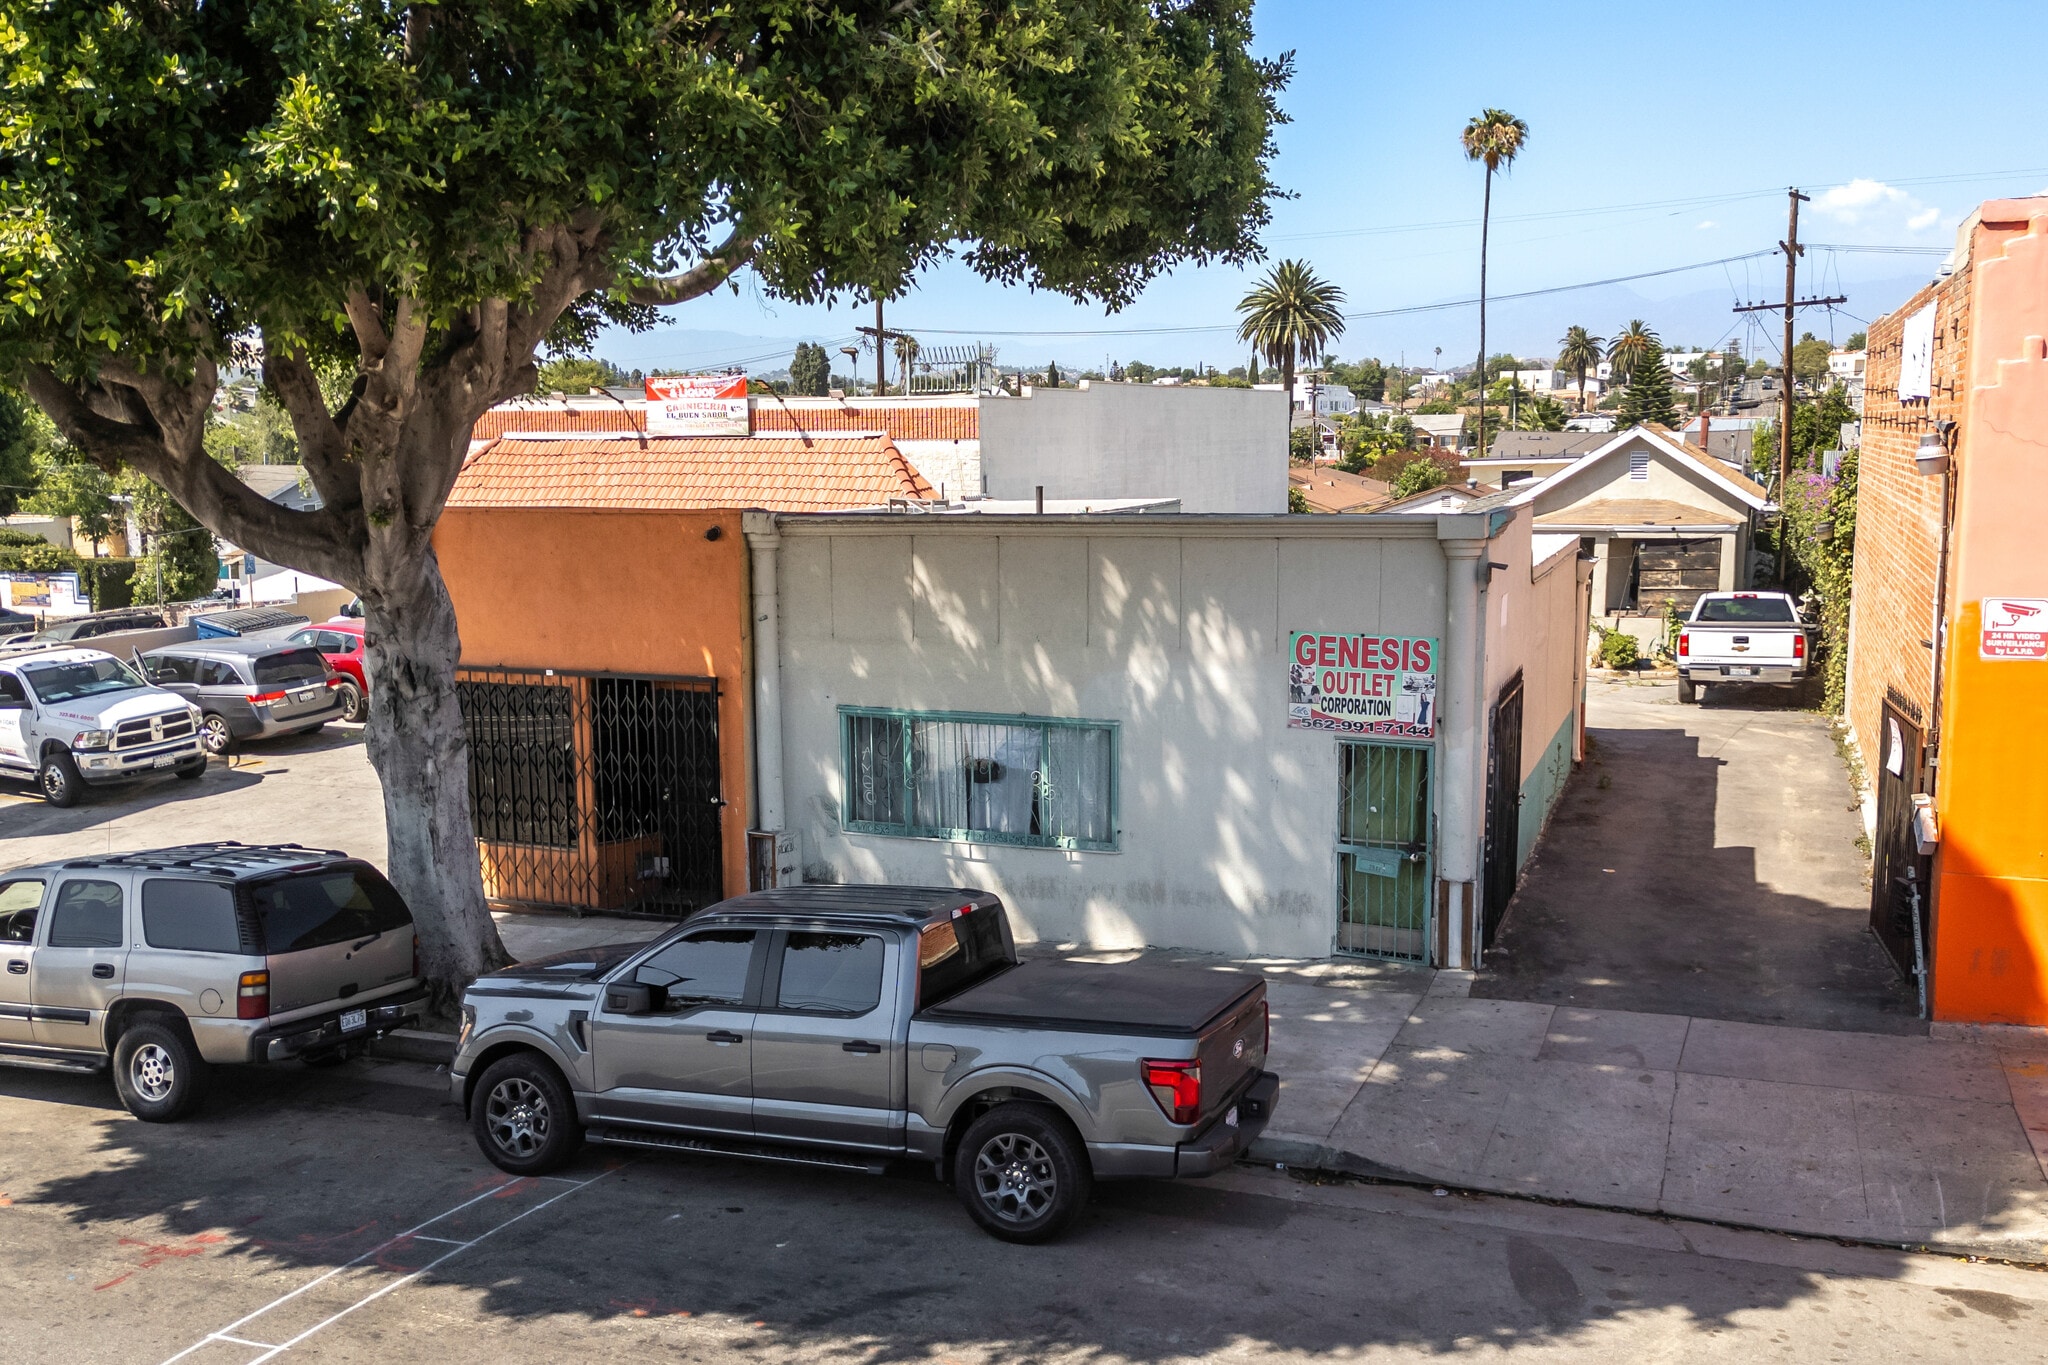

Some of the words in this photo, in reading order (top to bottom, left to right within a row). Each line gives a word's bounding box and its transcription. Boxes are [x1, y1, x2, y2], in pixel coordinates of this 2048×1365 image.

[679, 387, 716, 398] LIQUOR
[666, 402, 727, 412] CARNICERIA
[1295, 634, 1431, 673] GENESIS
[1986, 639, 2046, 648] SURVEILLANCE
[1322, 670, 1395, 697] OUTLET
[1320, 696, 1391, 717] CORPORATION
[1301, 717, 1431, 737] 562-991-7144
